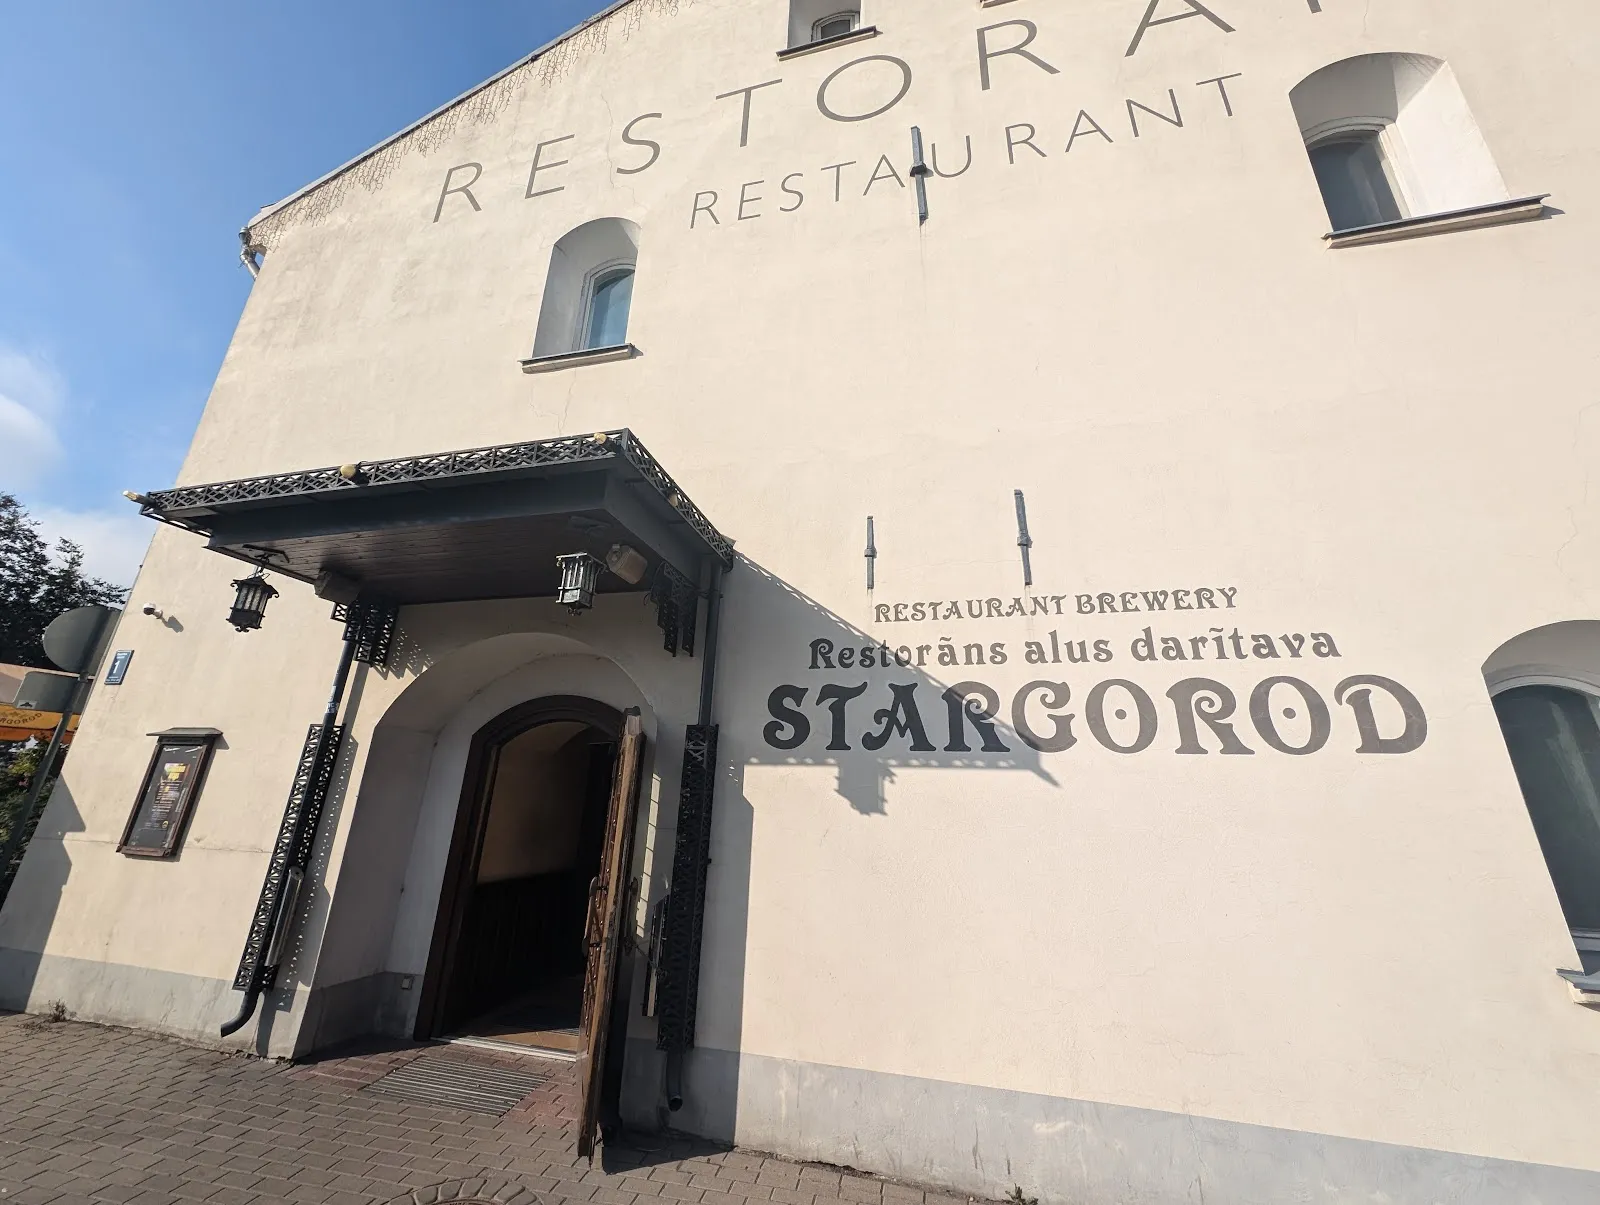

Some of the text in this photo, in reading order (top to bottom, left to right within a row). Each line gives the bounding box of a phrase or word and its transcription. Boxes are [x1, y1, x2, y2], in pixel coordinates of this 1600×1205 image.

[433, 0, 1322, 223] RESTORA
[690, 72, 1242, 229] RESTAURANT
[874, 586, 1238, 623] RESTAURANT BREWERY
[1024, 629, 1114, 665] alus
[762, 674, 1428, 756] STARGOROD
